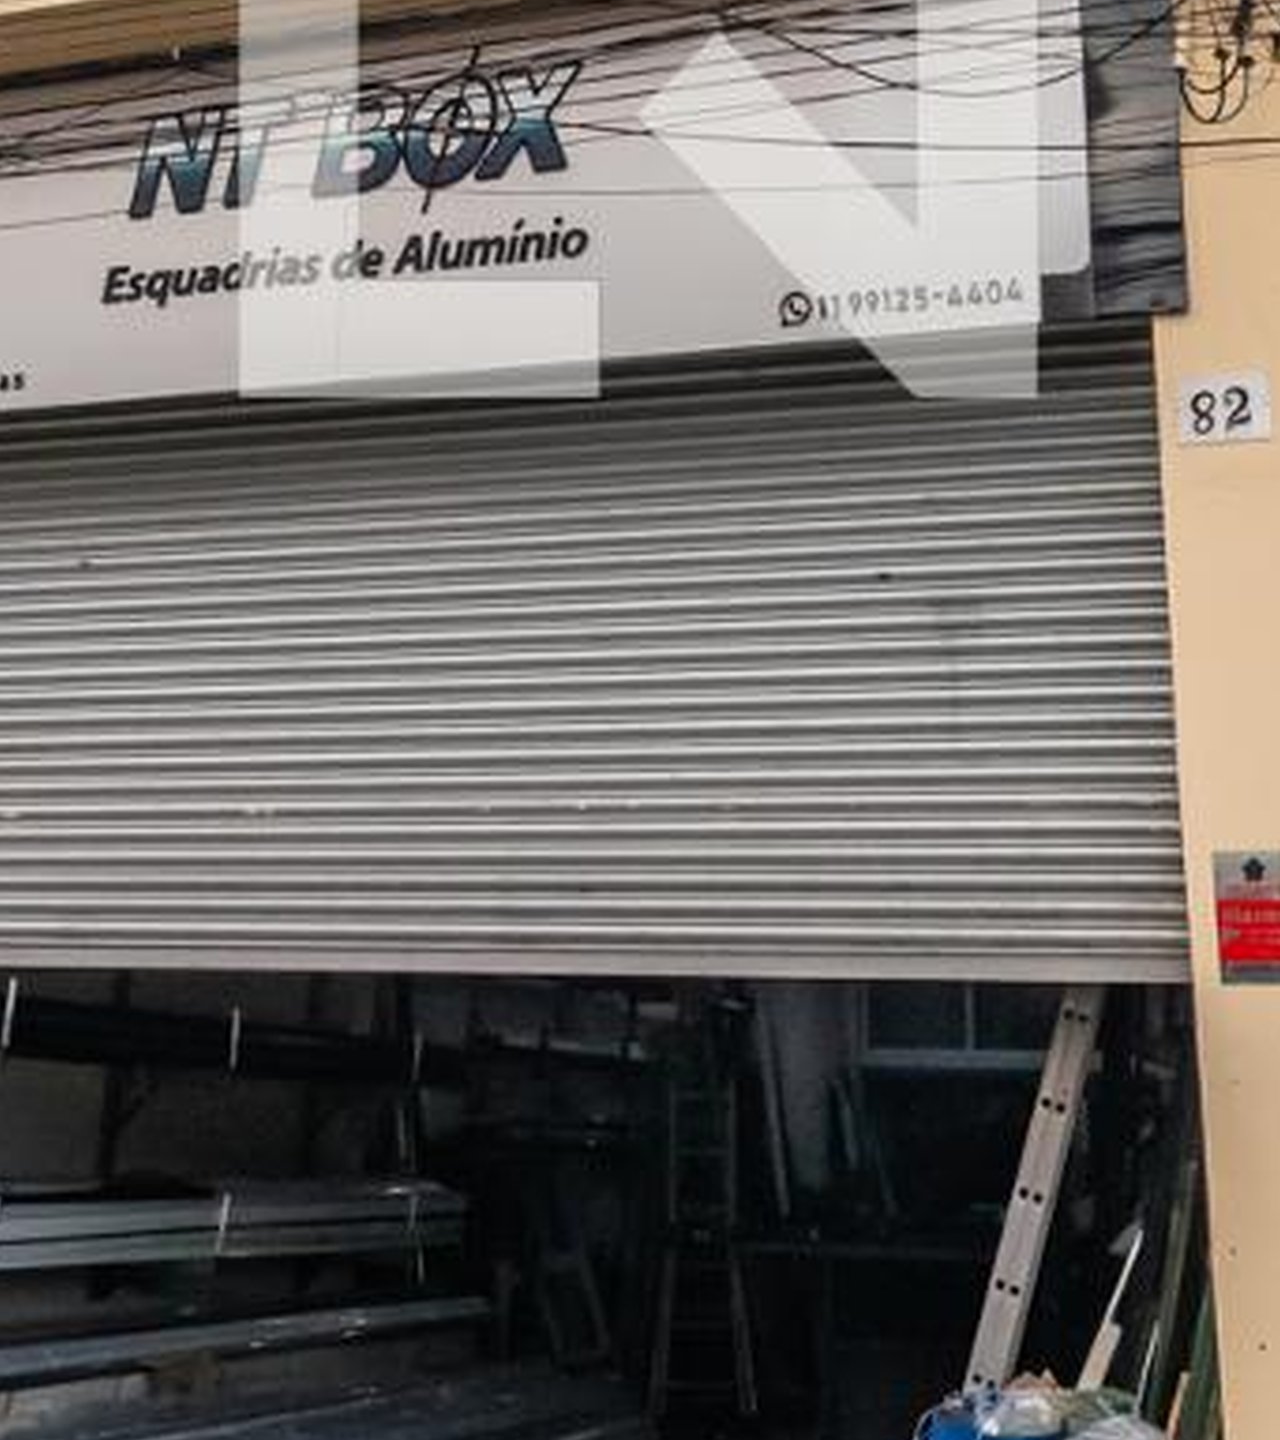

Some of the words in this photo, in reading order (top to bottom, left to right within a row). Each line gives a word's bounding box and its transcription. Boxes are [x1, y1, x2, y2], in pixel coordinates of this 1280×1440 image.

[311, 59, 583, 200] BOX
[101, 247, 321, 308] Esquadrias
[332, 239, 383, 280] de
[393, 218, 590, 276] Alumínio
[1190, 386, 1252, 435] 82
